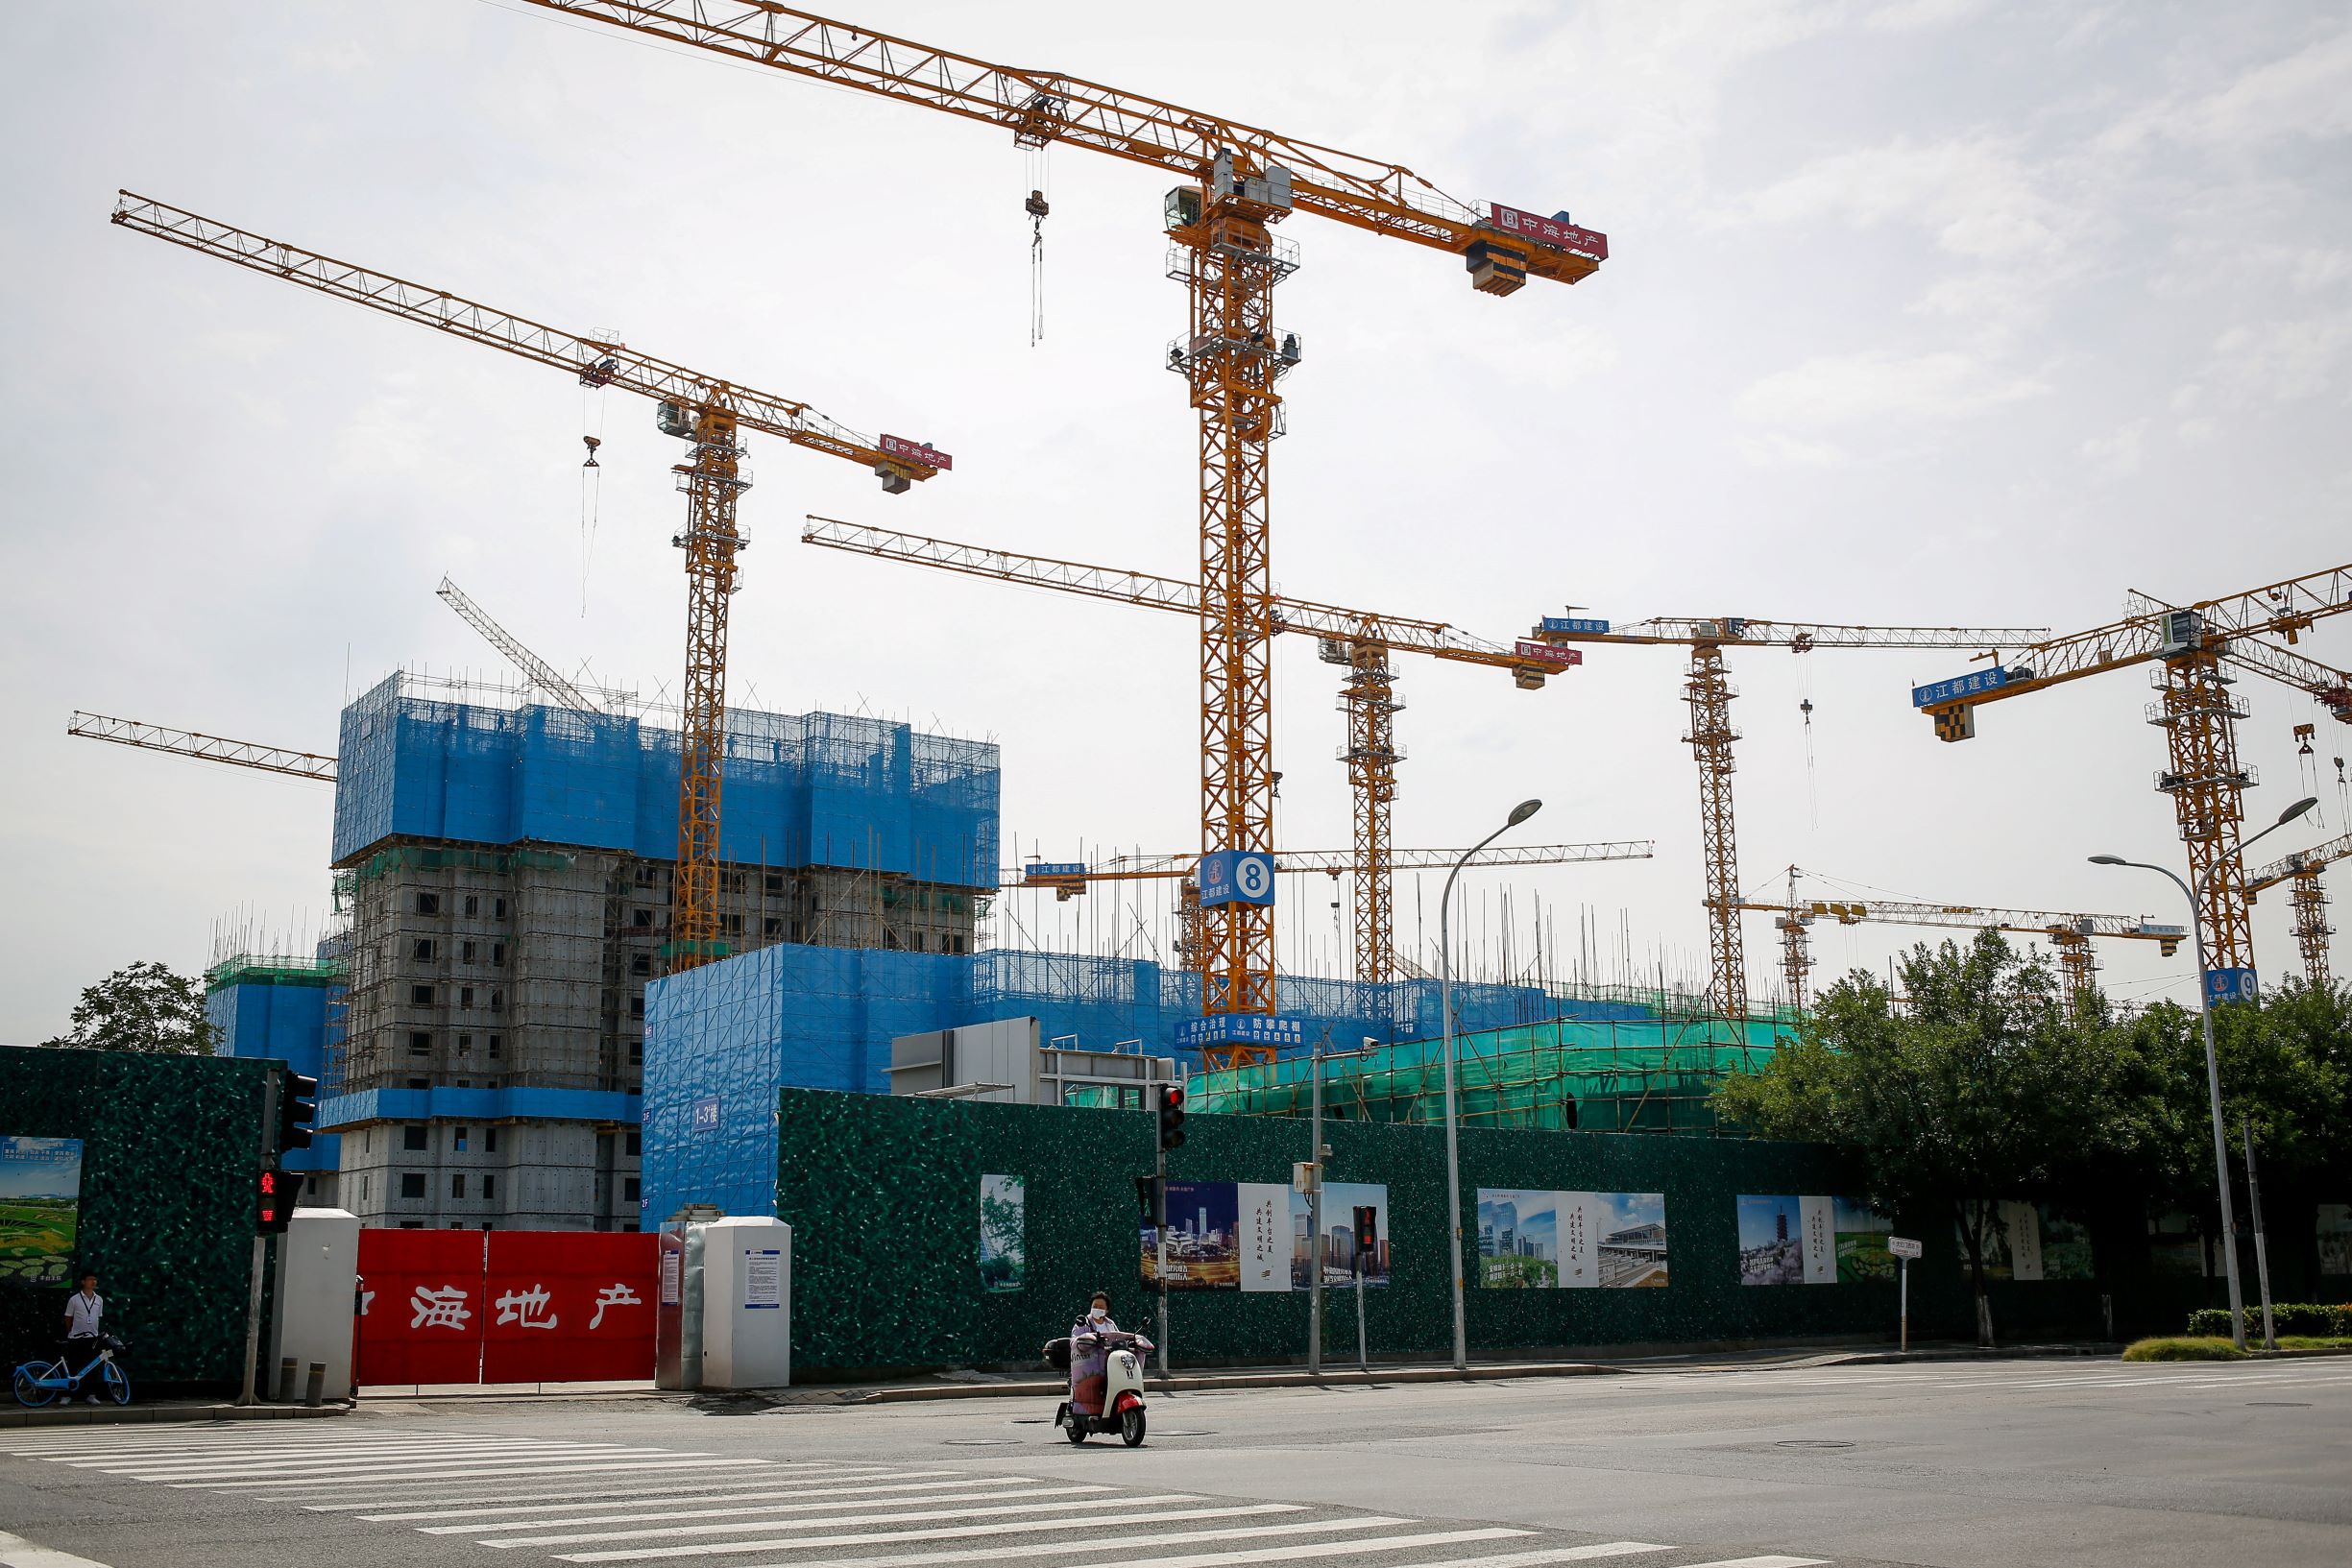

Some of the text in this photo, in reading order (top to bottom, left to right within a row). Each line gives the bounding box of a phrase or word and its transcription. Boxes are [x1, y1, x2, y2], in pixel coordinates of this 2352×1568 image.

[1521, 217, 1599, 247] 中海地产
[899, 445, 946, 463] 中海地产
[1561, 620, 1604, 632] 江都建设
[1534, 648, 1577, 660] 中海地产
[1936, 672, 1998, 698] 江都建设
[1042, 865, 1080, 874] 江都建设
[1246, 864, 1260, 890] 8
[1201, 885, 1230, 901] 江都建设
[2244, 977, 2252, 996] 9
[1190, 1016, 1226, 1033] 综合治理
